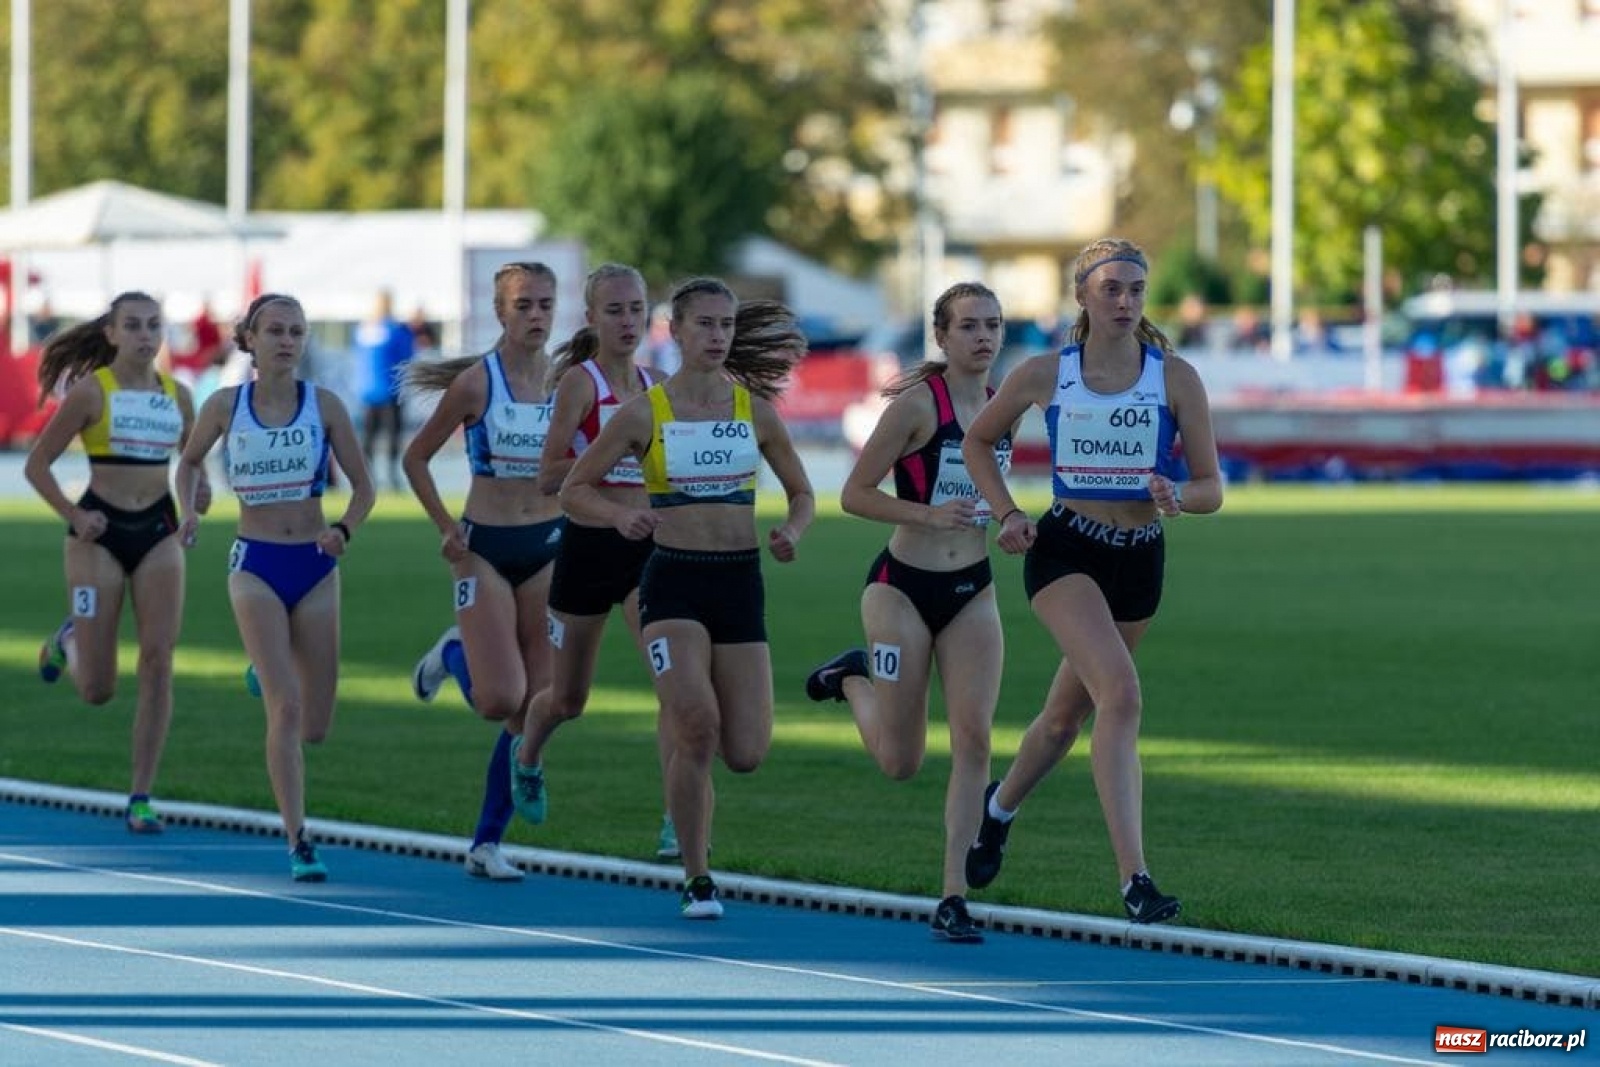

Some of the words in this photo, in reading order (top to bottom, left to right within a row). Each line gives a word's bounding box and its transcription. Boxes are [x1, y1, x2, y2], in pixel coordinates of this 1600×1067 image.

[1109, 407, 1151, 428] 604
[266, 429, 304, 450] 710
[711, 422, 749, 439] 660
[693, 449, 733, 465] LOSY
[1071, 438, 1143, 456] TOMALA
[233, 457, 308, 476] MUSIELAK
[683, 483, 720, 493] RADOM
[1073, 474, 1113, 485] RADOM
[1115, 476, 1140, 485] 2020
[1068, 513, 1127, 547] NIKE
[77, 590, 89, 613] 3
[458, 581, 469, 606] 8
[650, 642, 665, 671] 5
[874, 650, 898, 676] 10
